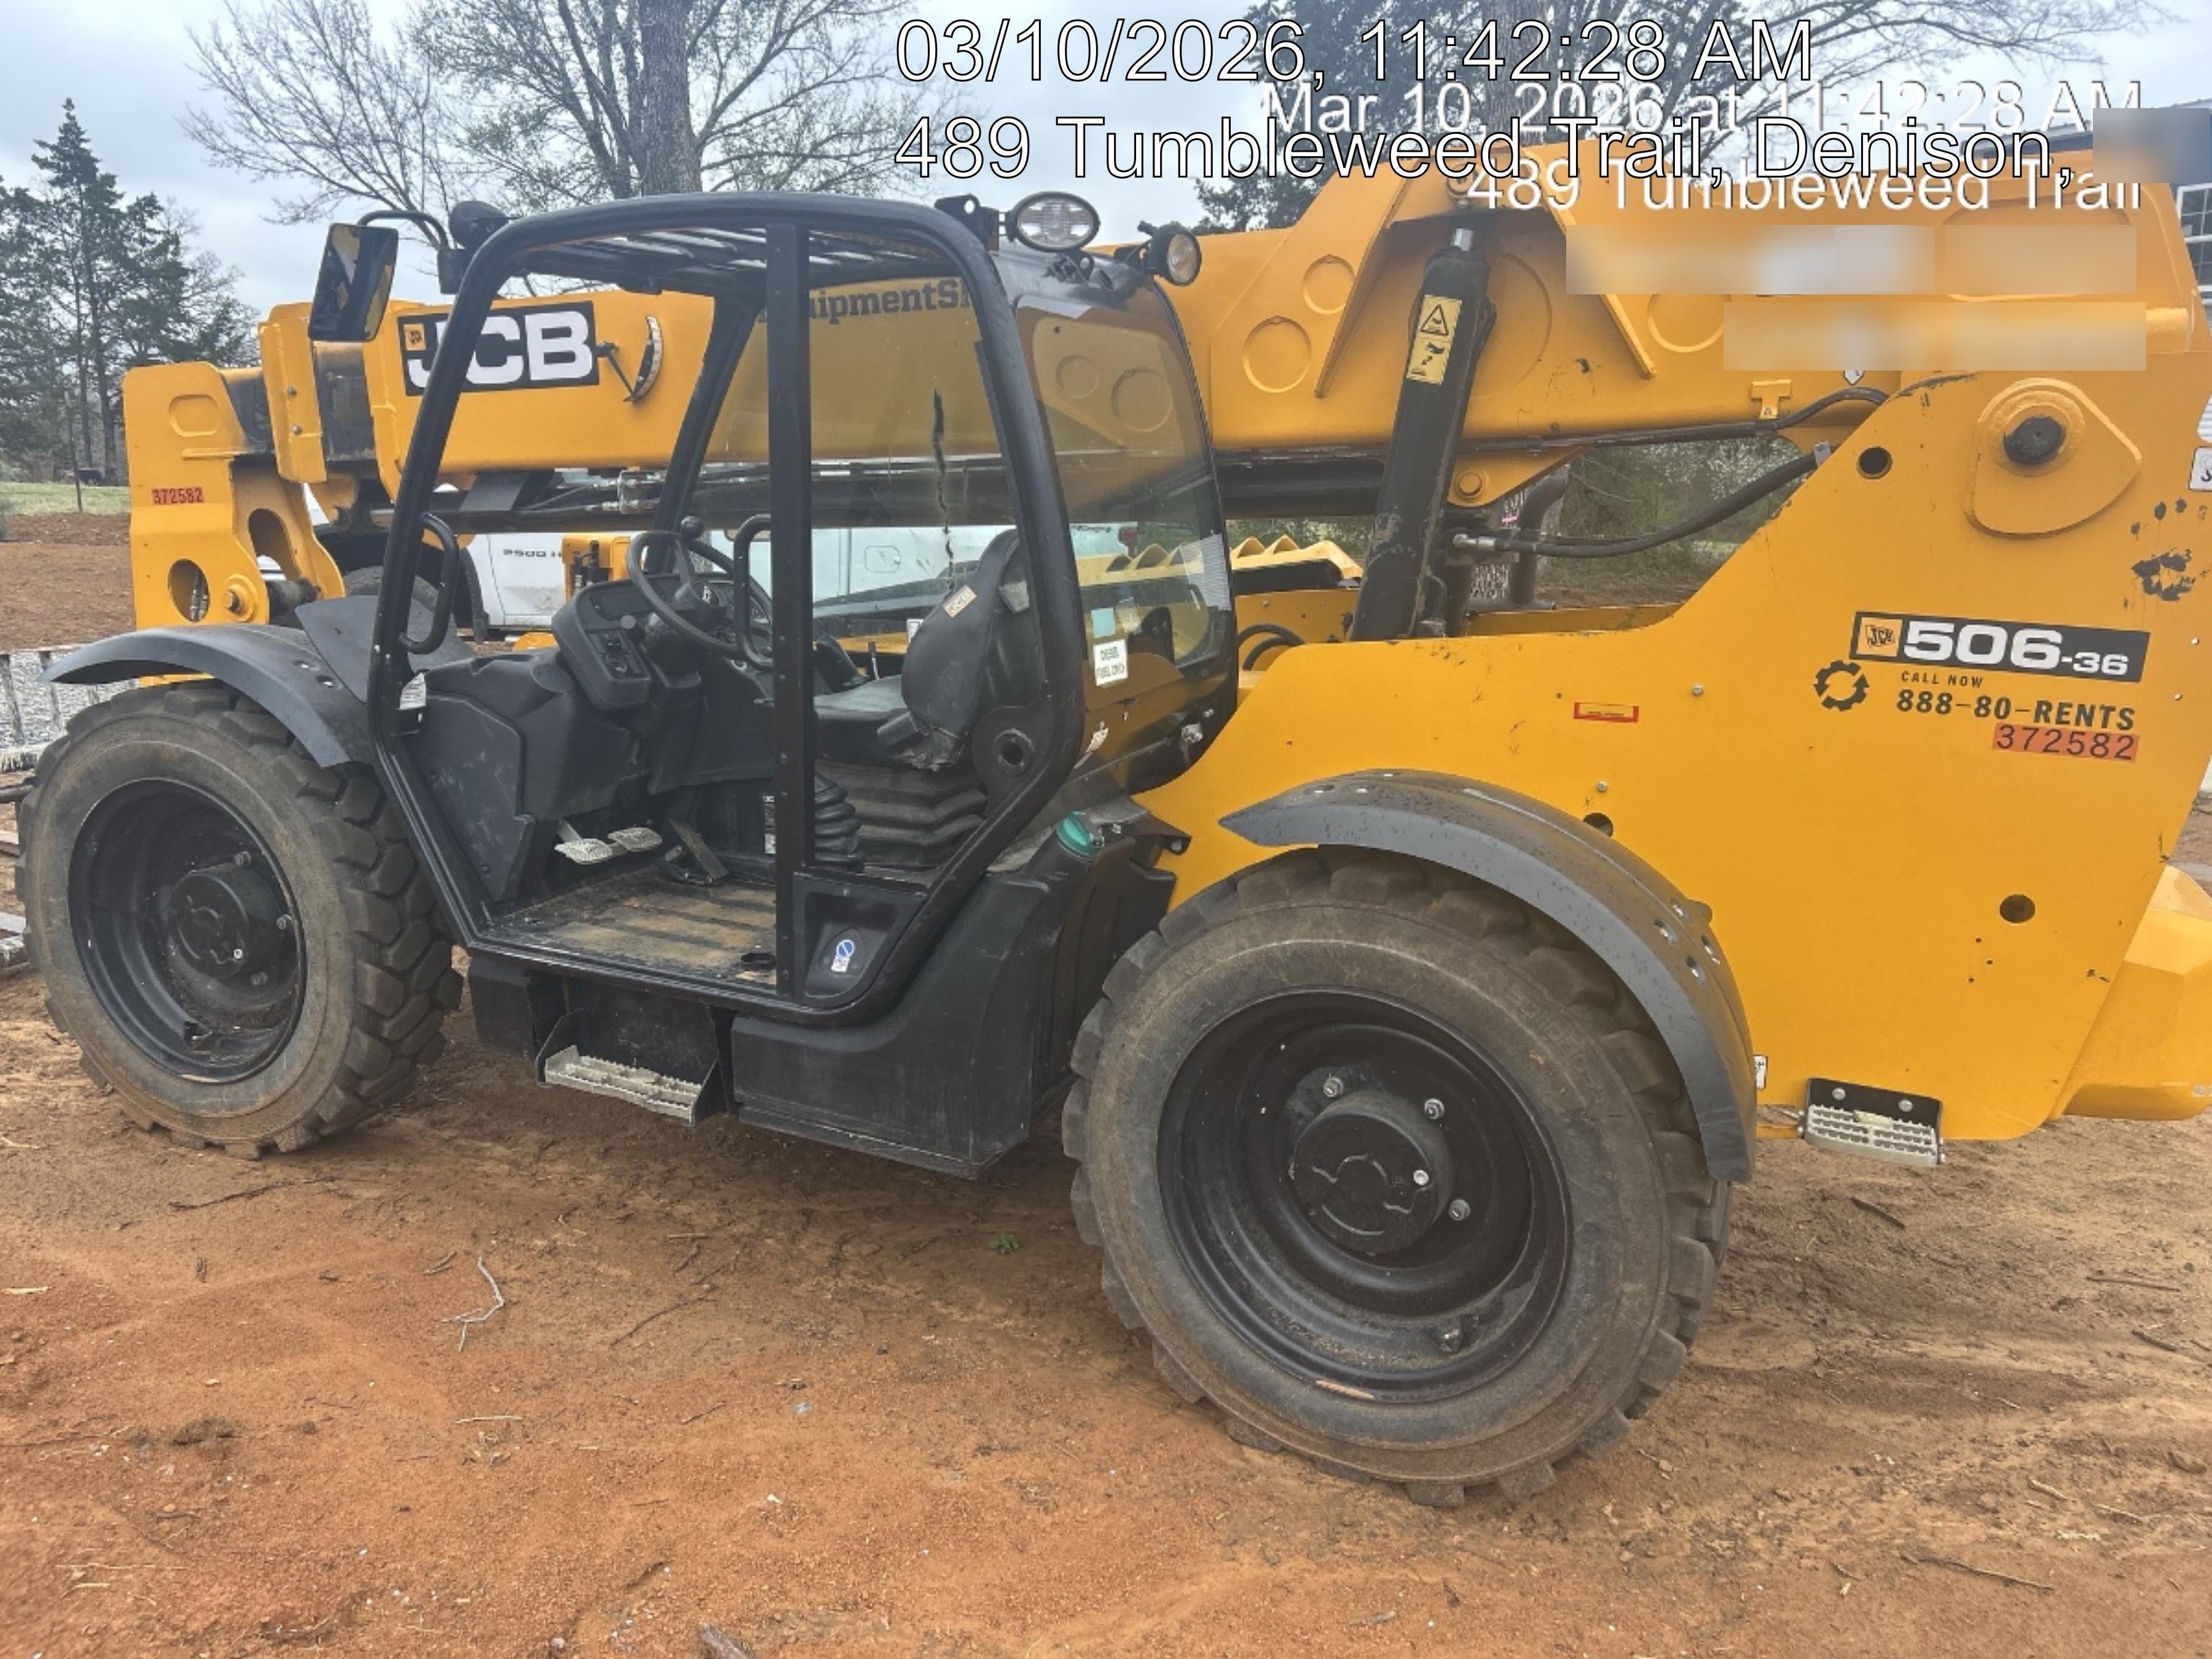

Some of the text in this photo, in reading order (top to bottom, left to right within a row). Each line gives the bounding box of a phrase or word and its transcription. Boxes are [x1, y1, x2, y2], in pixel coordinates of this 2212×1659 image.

[152, 487, 205, 504] 372582
[1904, 621, 2129, 675] 506-36
[1901, 670, 1983, 688] CALL NOW
[1896, 689, 2135, 731] 888-80-RENTS
[1996, 723, 2135, 761] 372582
